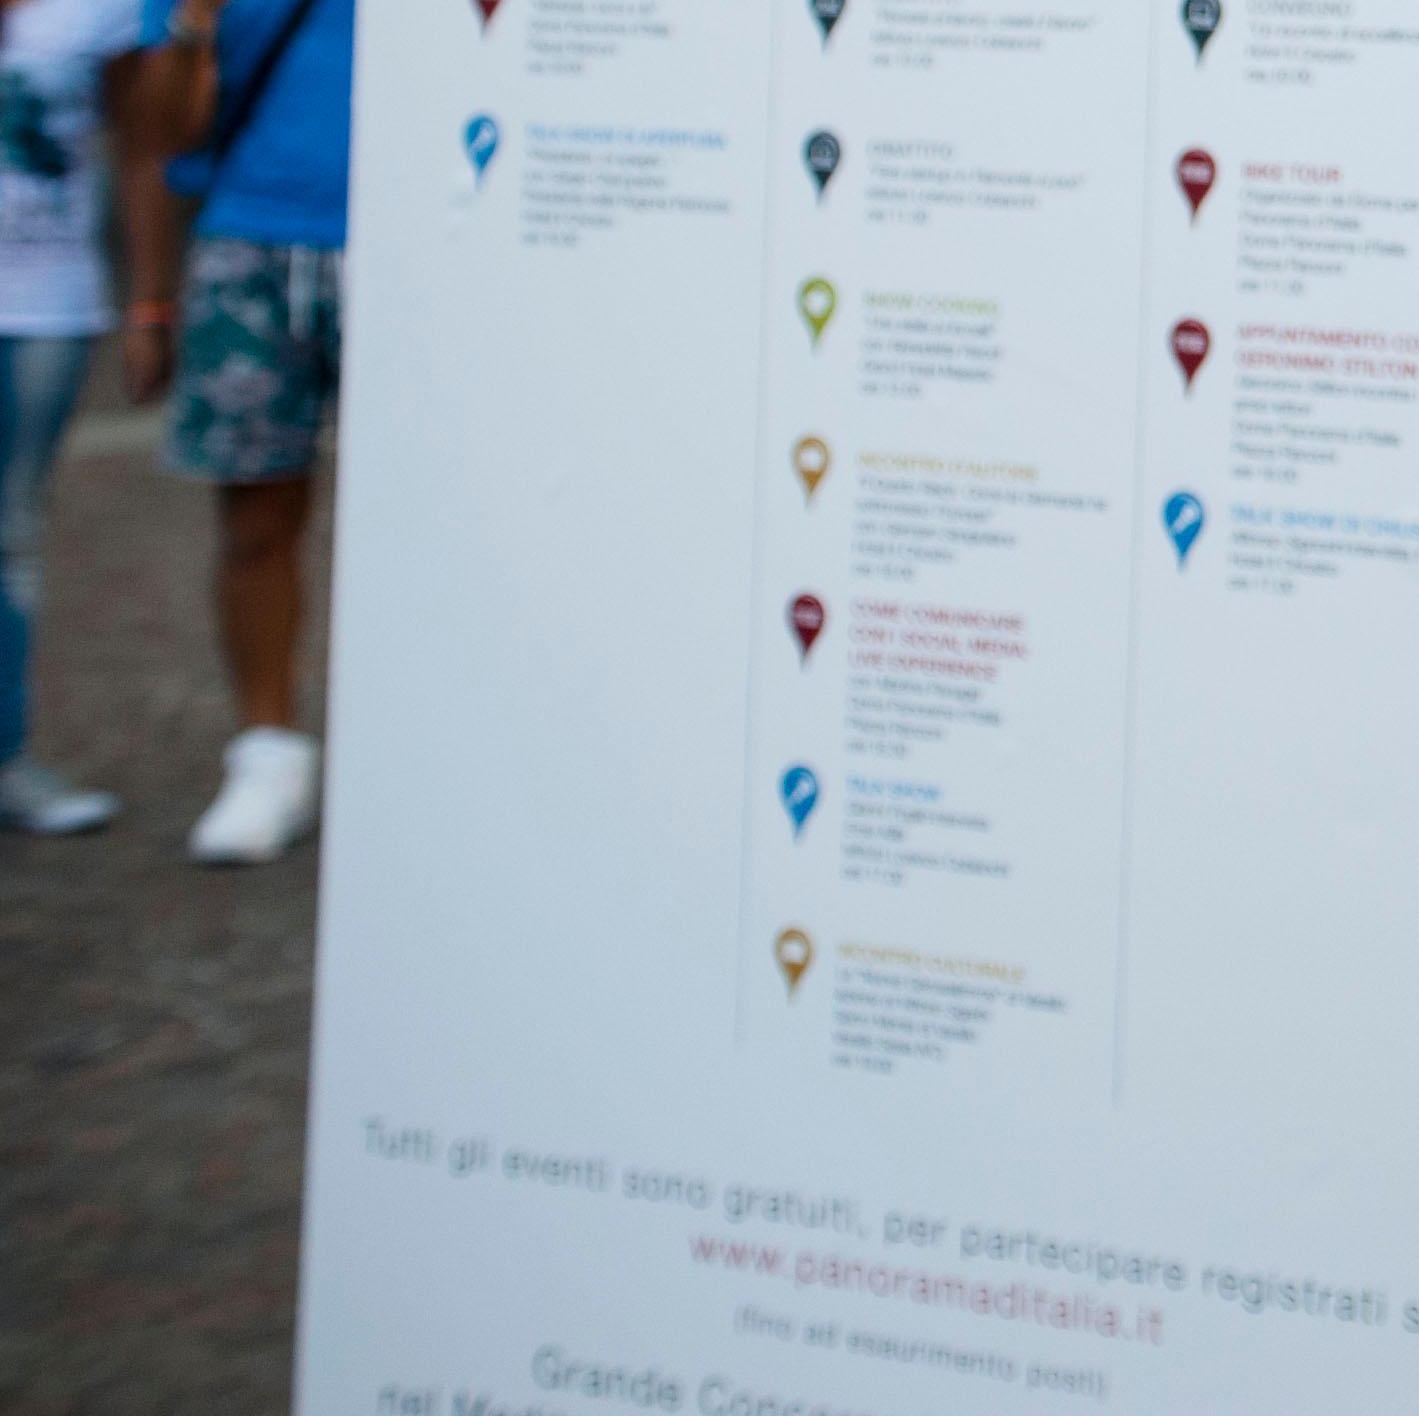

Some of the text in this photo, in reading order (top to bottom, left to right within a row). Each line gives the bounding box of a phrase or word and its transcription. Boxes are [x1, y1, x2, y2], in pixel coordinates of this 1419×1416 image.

[361, 1115, 435, 1165] Tutti
[447, 1137, 489, 1180] gli
[501, 1148, 607, 1195] eventi
[621, 1165, 713, 1212] sono
[723, 1181, 868, 1240] gratuiti,
[882, 1207, 948, 1251] per
[958, 1220, 1186, 1290] partecipare
[1200, 1263, 1391, 1328] registrati
[687, 1231, 1166, 1348] www.panoramaditalia.it
[530, 1340, 686, 1413] Grande
